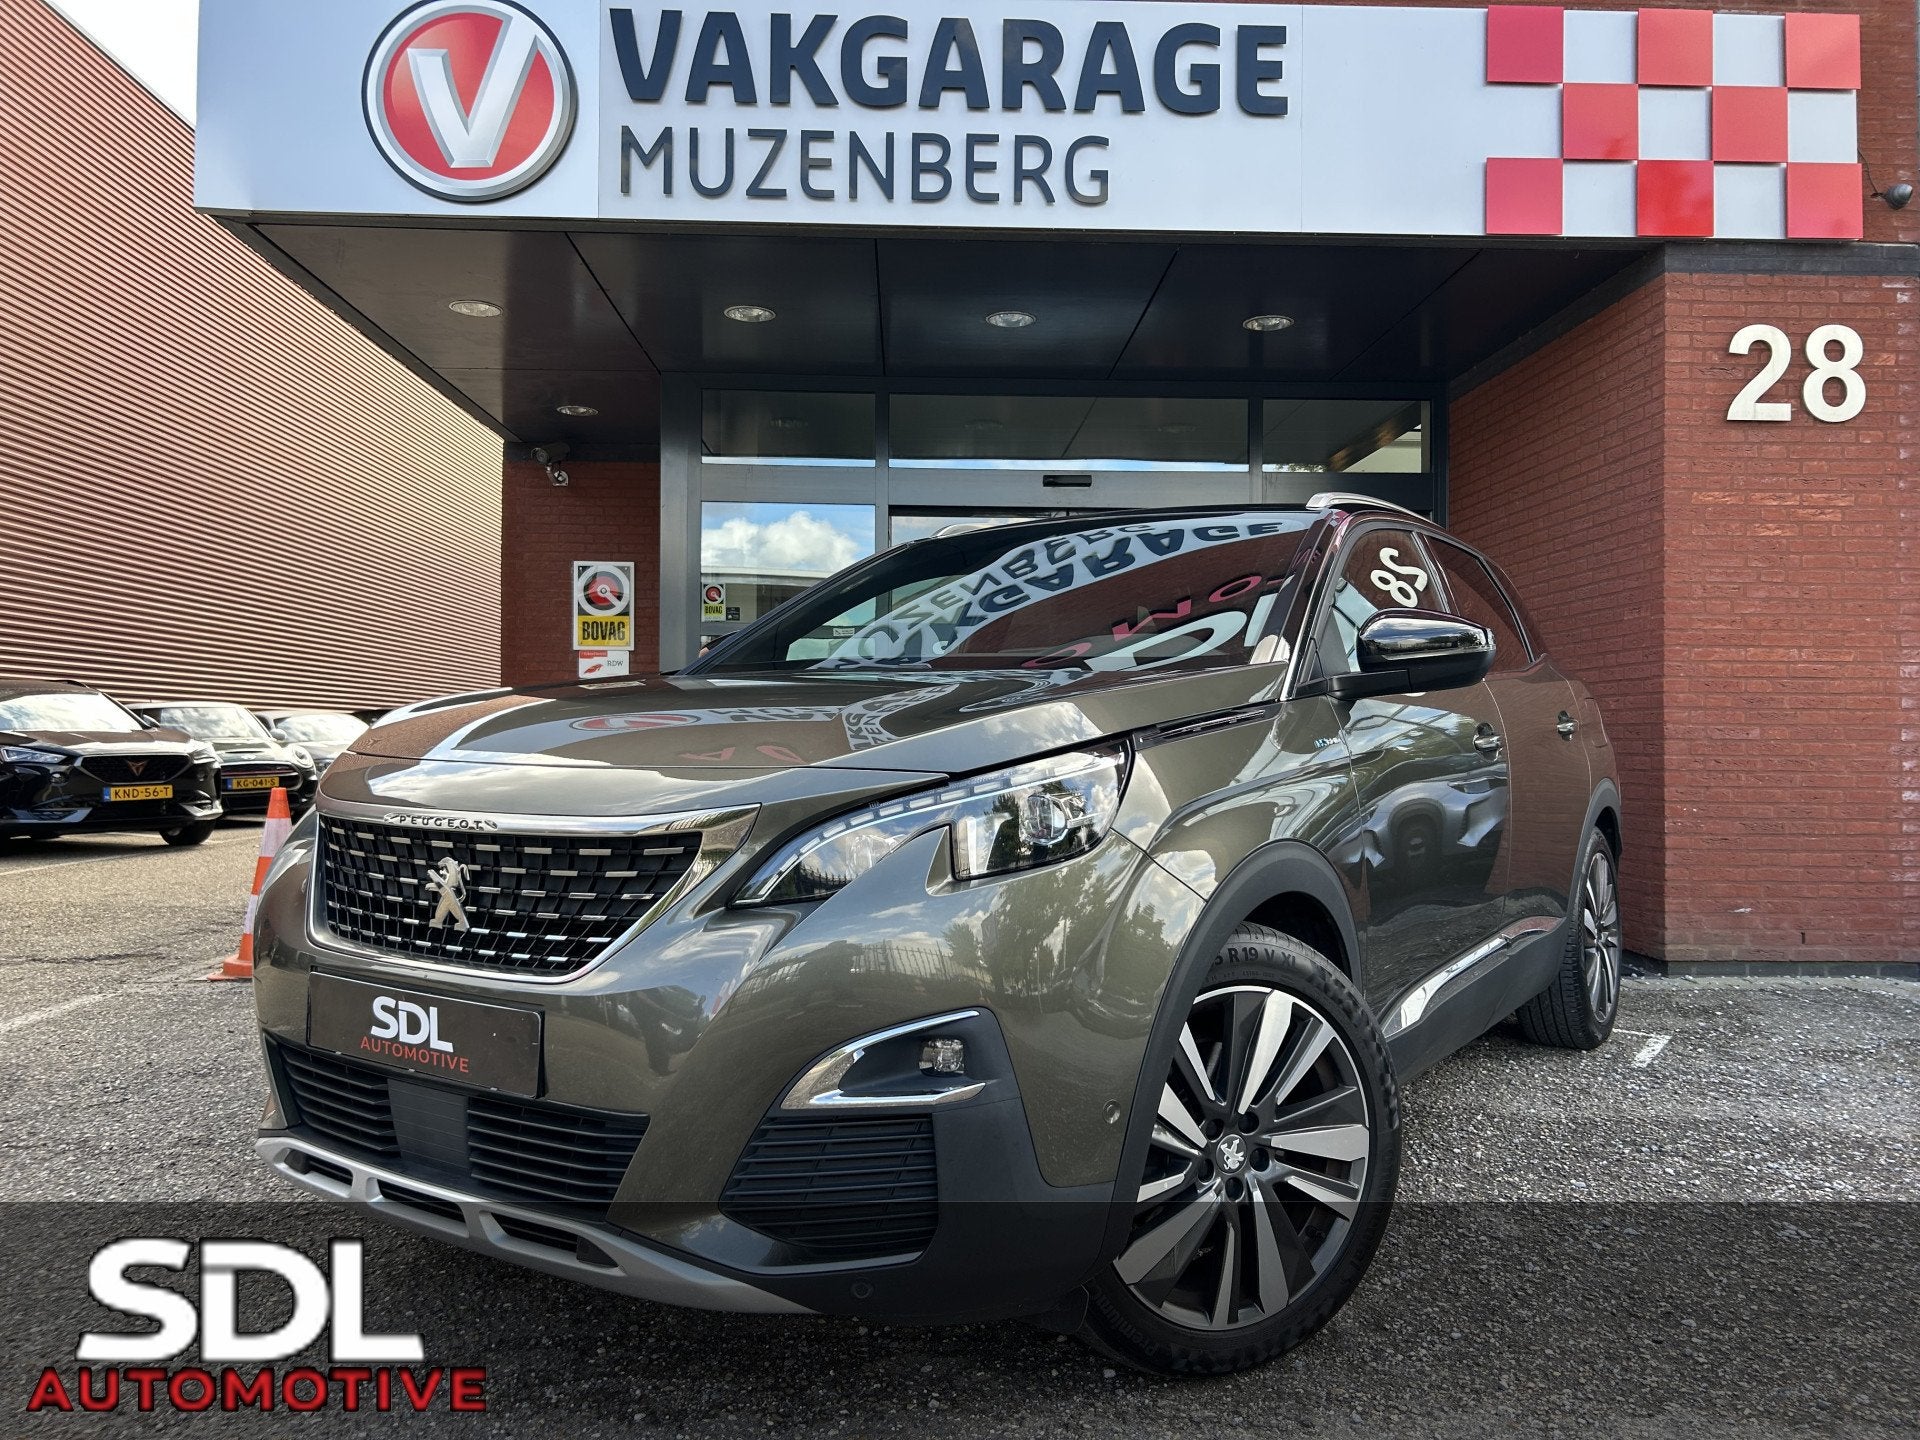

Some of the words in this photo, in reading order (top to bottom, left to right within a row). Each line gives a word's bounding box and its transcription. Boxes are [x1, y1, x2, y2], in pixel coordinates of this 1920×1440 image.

[609, 7, 1290, 117] VAKGARAGE
[406, 17, 541, 169] V
[620, 125, 1111, 206] MUZENBERG
[1725, 323, 1868, 424] 28
[704, 605, 723, 615] BOVAG
[582, 620, 626, 641] BOVAG
[606, 659, 624, 667] RDW
[114, 785, 171, 800] KND-56-T
[235, 778, 277, 789] KG-041-S
[399, 815, 482, 830] PEUGEOT
[370, 995, 454, 1053] SDL
[360, 1035, 470, 1074] AUTOMOTIVE
